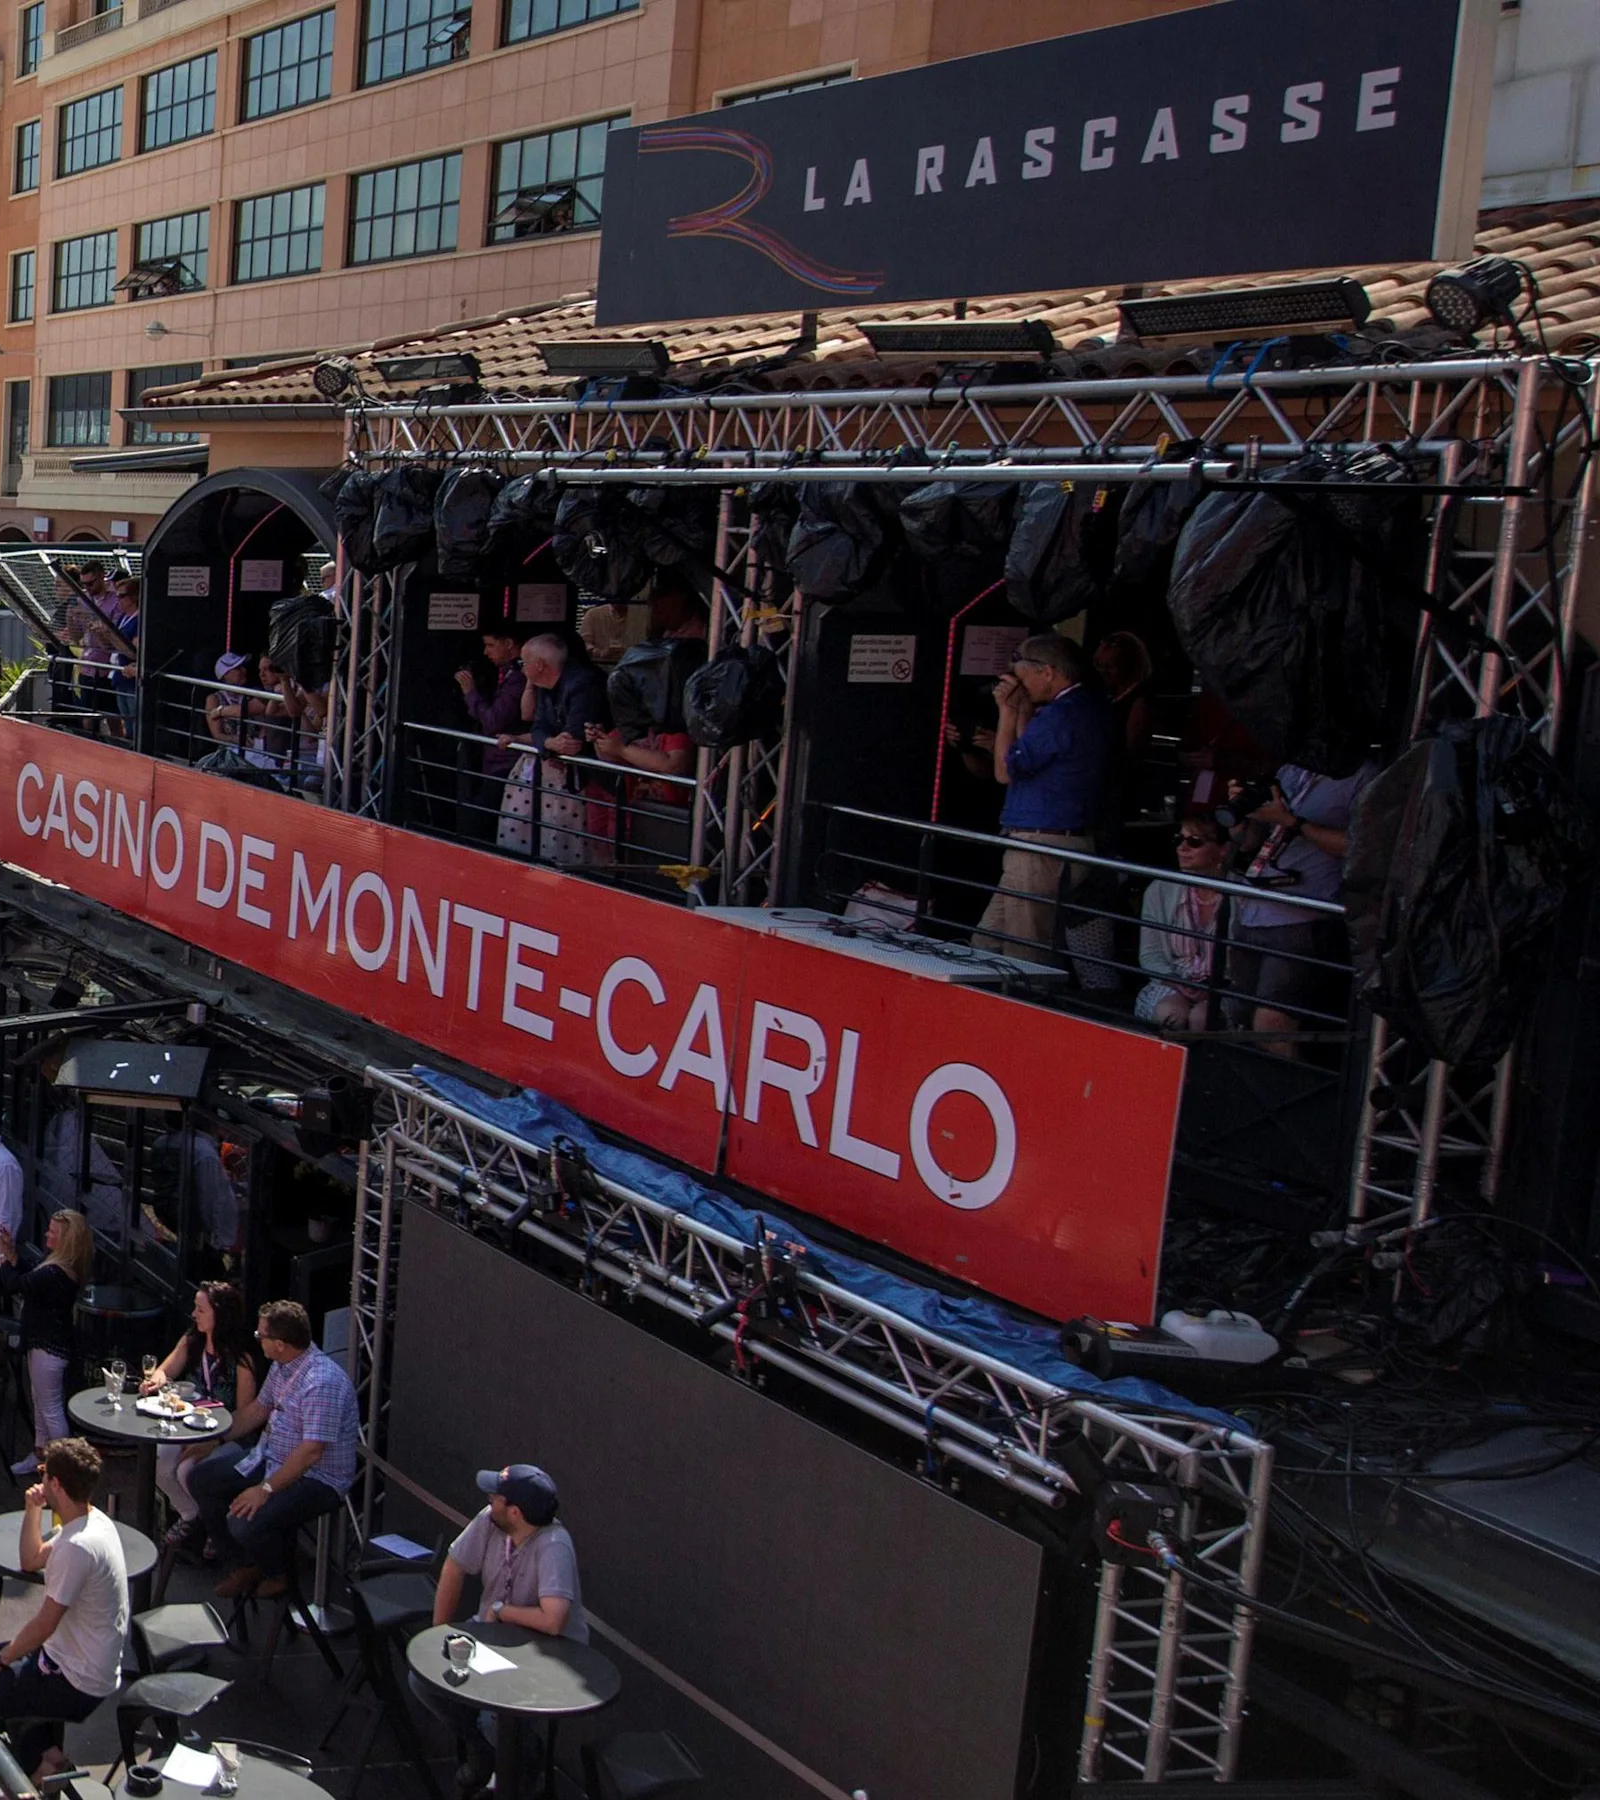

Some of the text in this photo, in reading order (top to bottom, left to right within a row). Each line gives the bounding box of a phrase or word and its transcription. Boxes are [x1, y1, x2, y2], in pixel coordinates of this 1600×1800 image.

[803, 66, 1402, 213] LA RASCASSE
[15, 760, 1016, 1210] CASINO DE MONTE-CARLO
